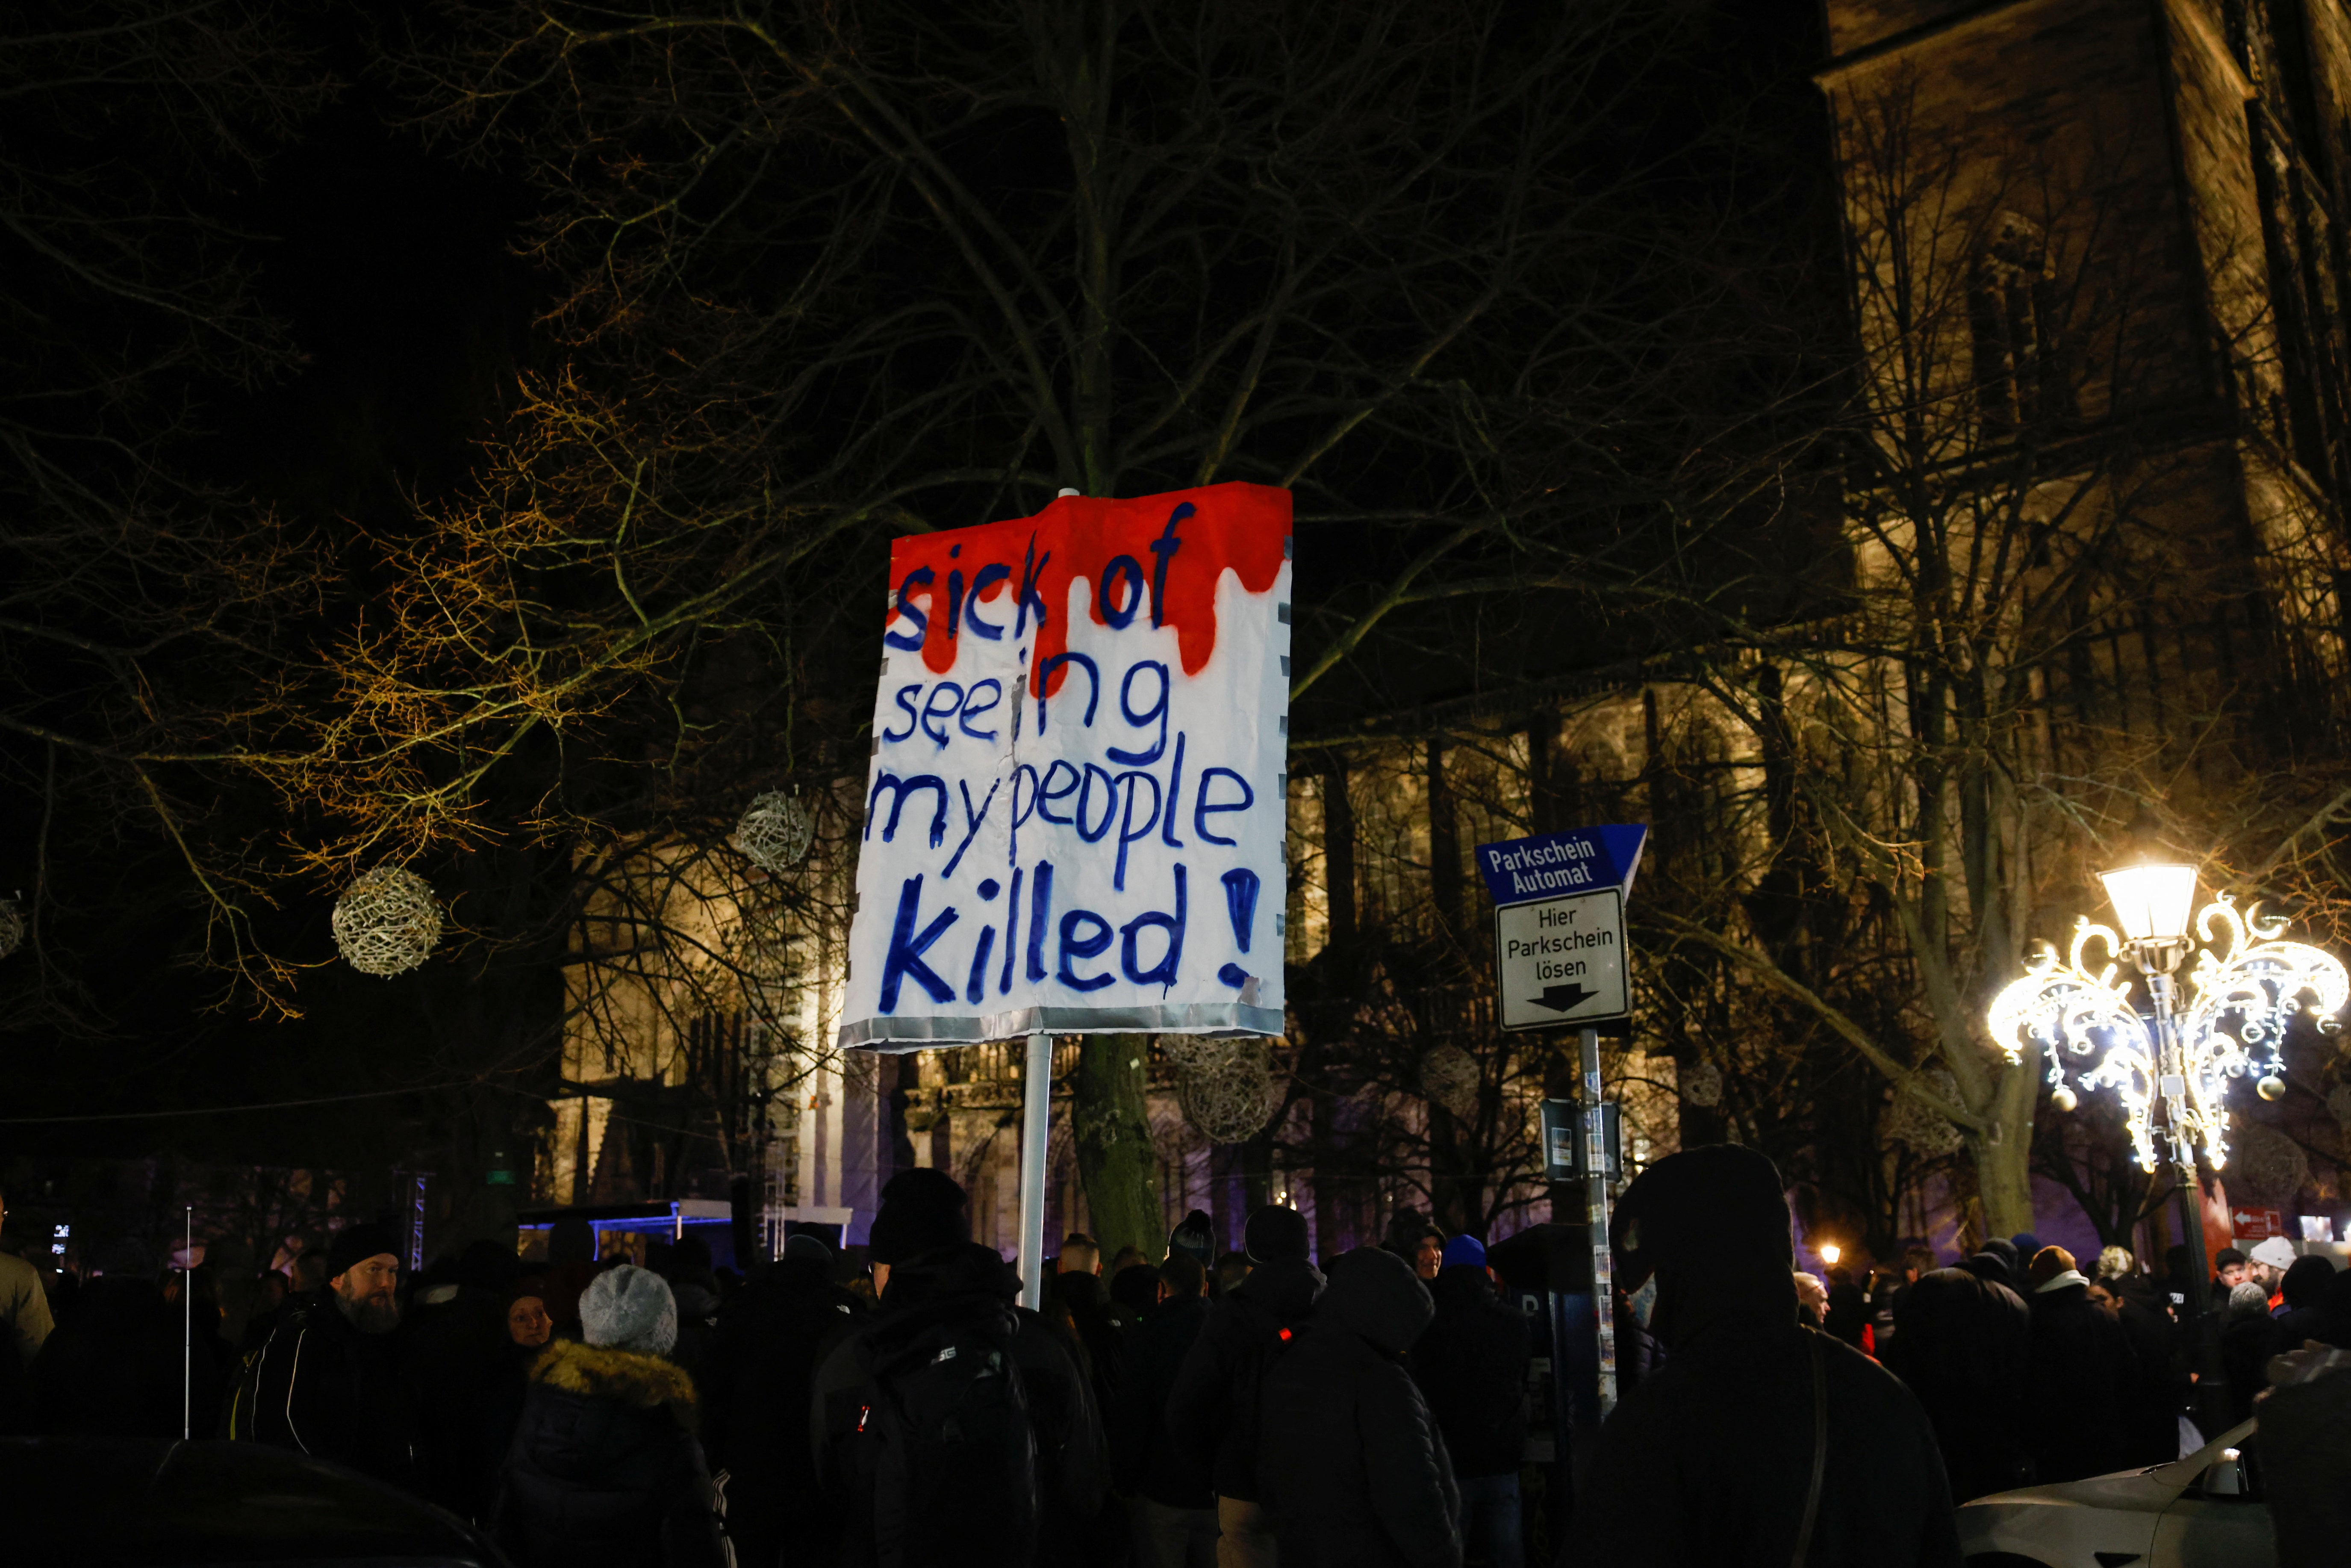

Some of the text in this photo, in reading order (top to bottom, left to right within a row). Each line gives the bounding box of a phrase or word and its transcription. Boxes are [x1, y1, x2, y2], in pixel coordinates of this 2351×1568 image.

[884, 502, 1197, 652] sick of
[882, 646, 1169, 765] seeing
[864, 732, 1255, 892] my people
[1488, 836, 1595, 873] Parkschein
[1512, 861, 1593, 894] Automat
[1539, 908, 1577, 928] Hier
[1508, 927, 1613, 959] Parkschein
[1536, 960, 1586, 980] lösen
